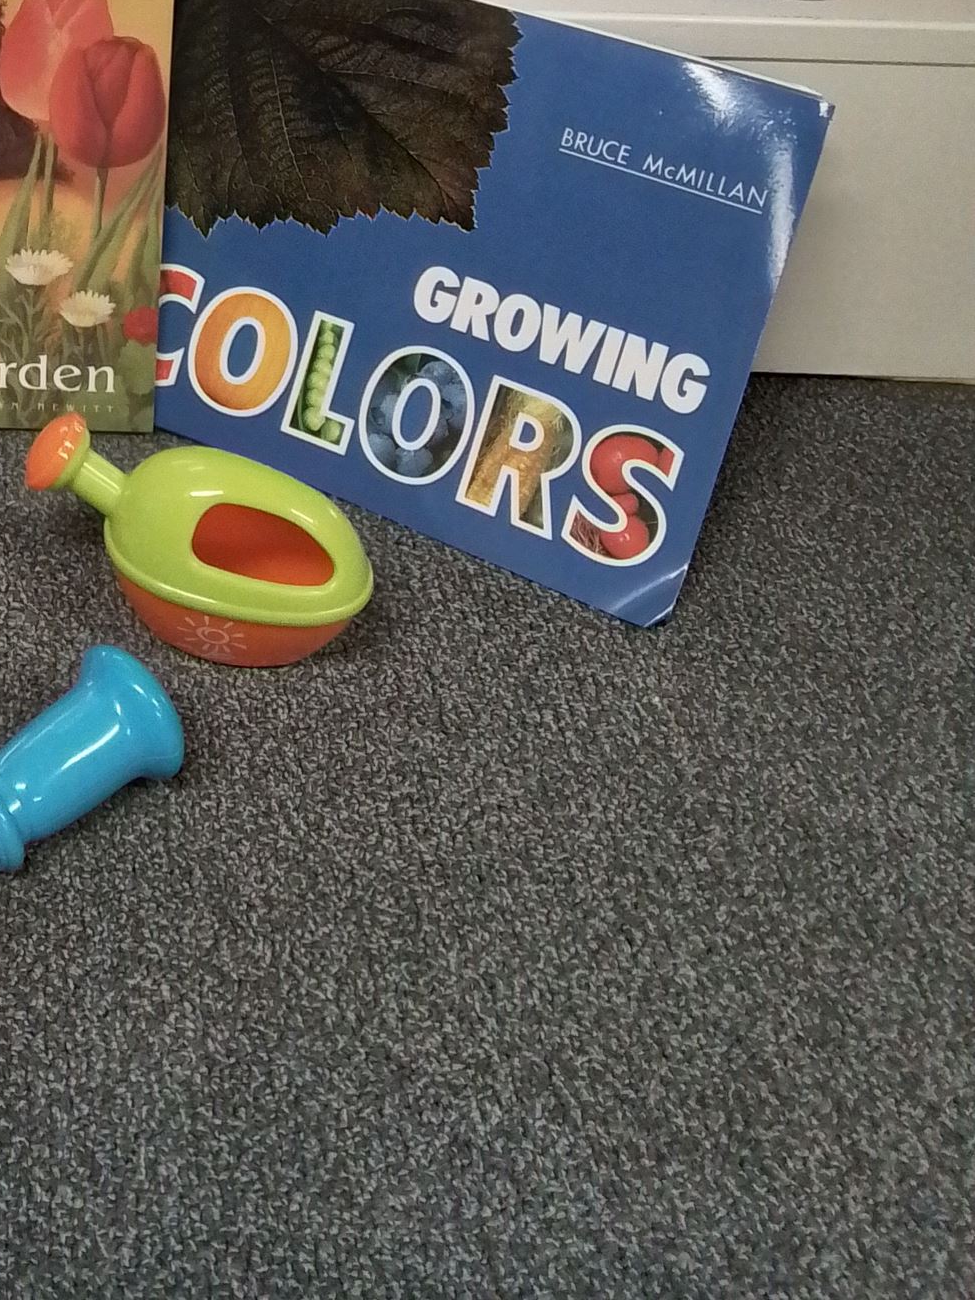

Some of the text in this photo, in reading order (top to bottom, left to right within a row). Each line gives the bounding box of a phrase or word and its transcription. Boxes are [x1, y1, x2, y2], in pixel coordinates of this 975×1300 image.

[561, 127, 768, 207] BRUCE McMILLAN
[155, 263, 686, 566] COLORS
[413, 265, 712, 415] GROWING
